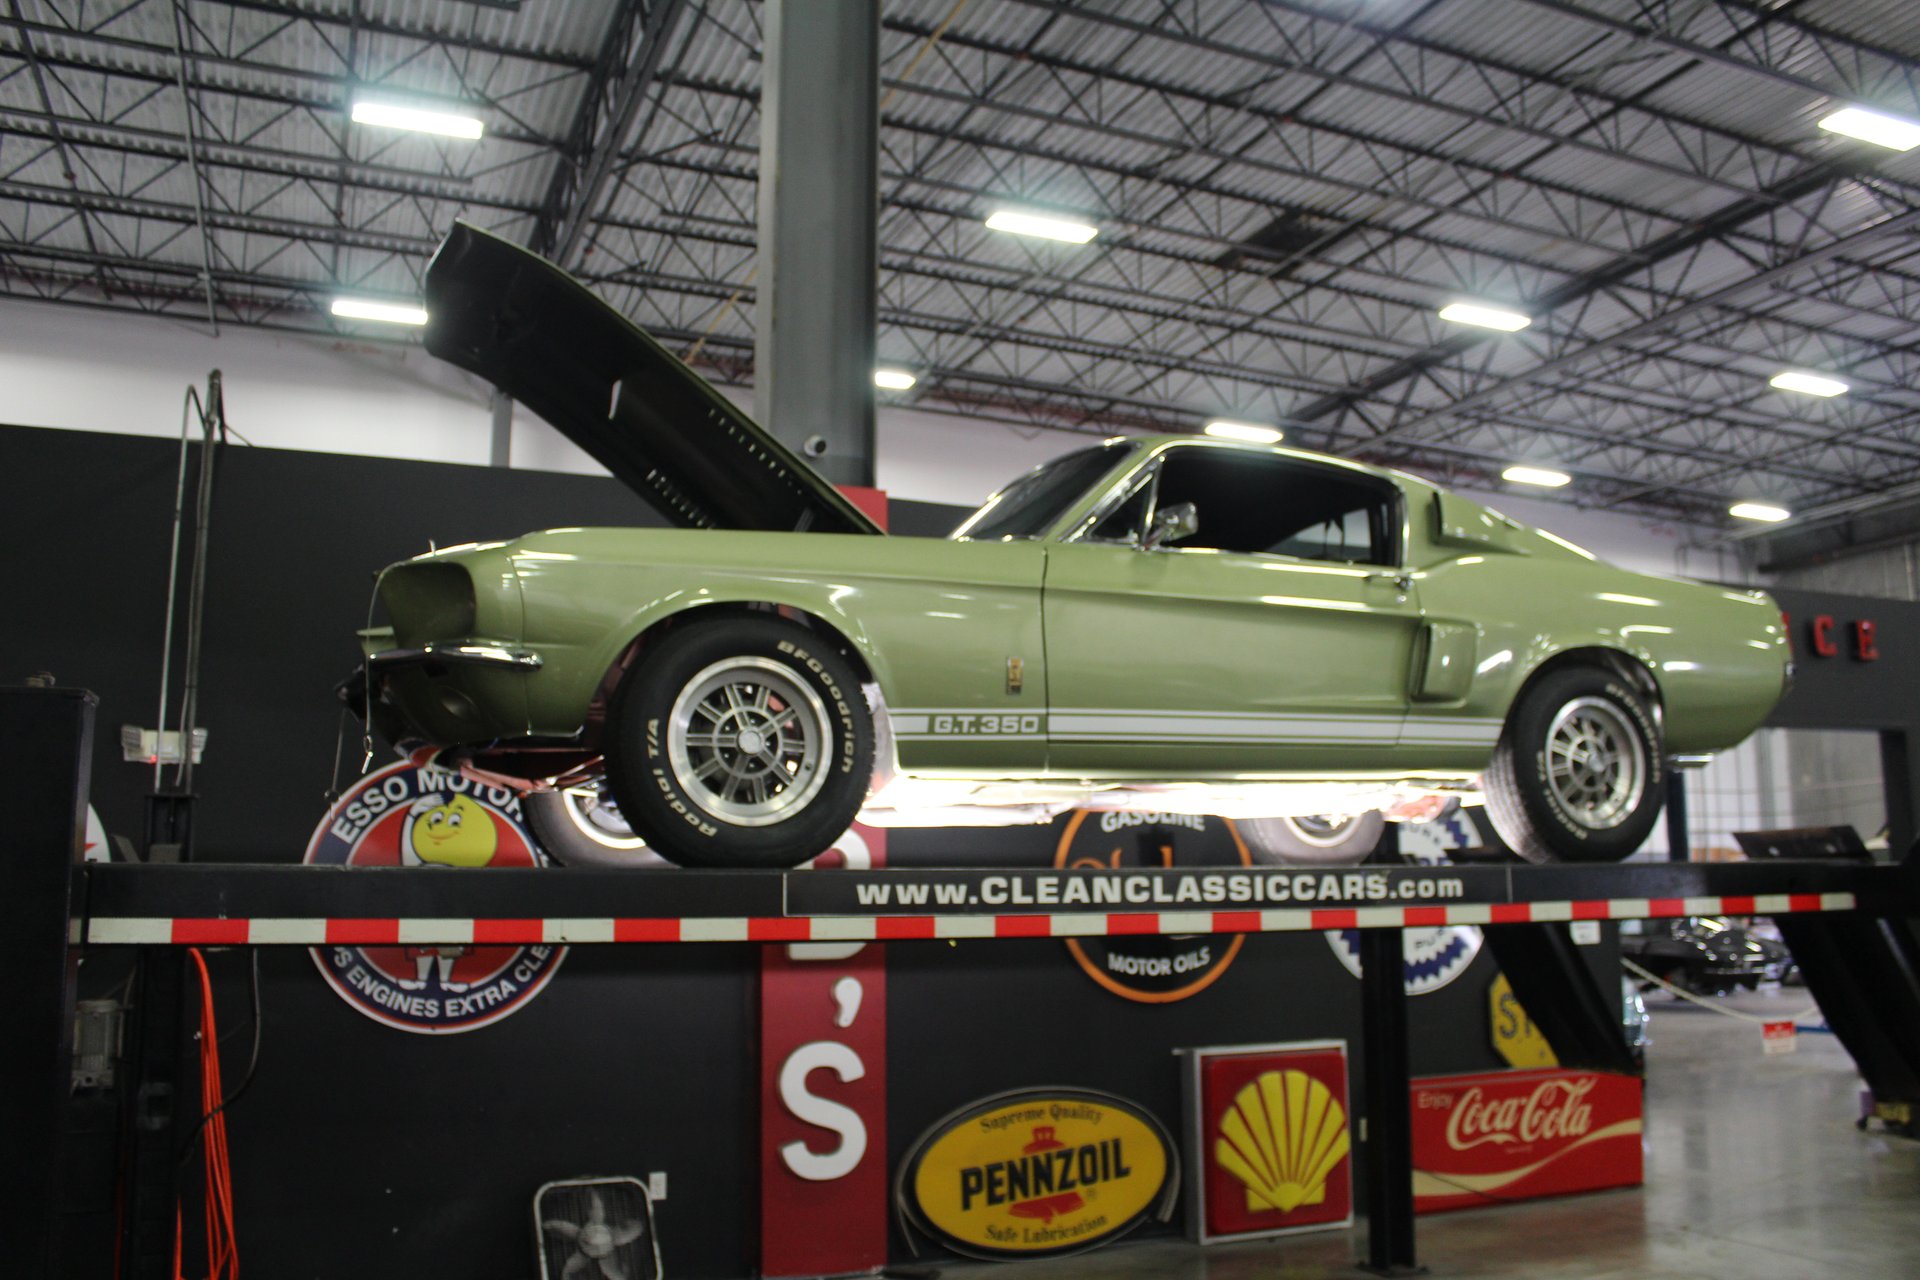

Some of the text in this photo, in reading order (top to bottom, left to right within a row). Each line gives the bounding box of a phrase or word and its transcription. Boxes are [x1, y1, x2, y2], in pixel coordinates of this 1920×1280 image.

[330, 775, 408, 844] ESSO
[1108, 945, 1211, 976] MOTOR OILS
[346, 963, 440, 1018] ENGINES
[445, 978, 518, 1018] EXTRA
[980, 1103, 1104, 1133] Supreme Quality
[1417, 1077, 1598, 1151] Enjoy Coca-Cola
[960, 1137, 1132, 1212] PENNZOIL
[984, 1214, 1109, 1244] Safe Lubrication
